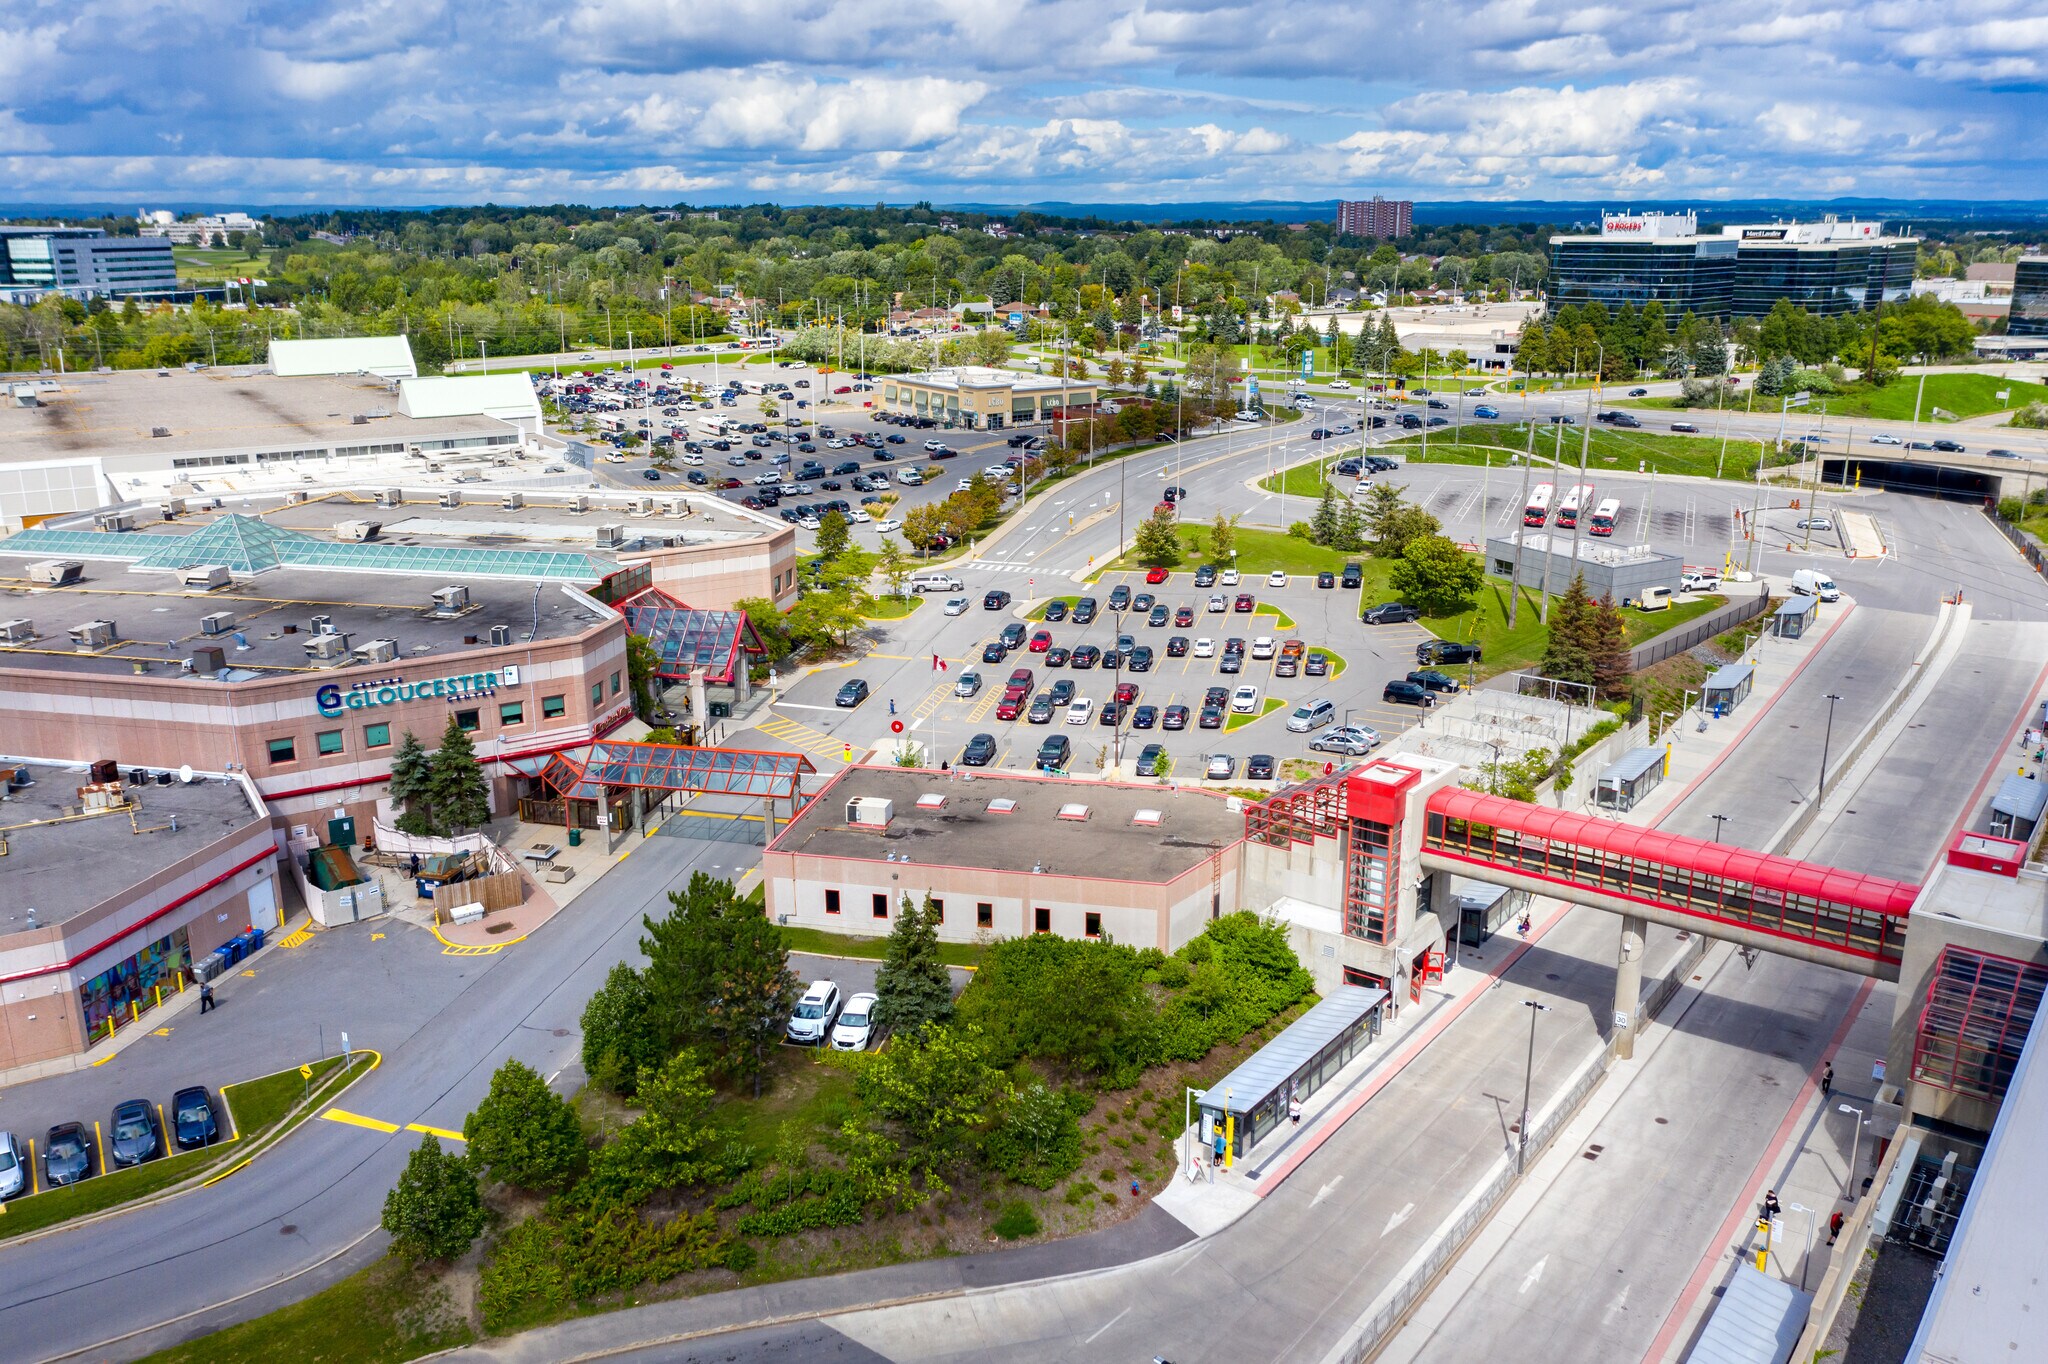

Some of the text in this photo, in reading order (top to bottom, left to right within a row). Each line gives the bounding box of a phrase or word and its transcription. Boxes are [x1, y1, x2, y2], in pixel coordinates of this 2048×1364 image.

[1615, 222, 1642, 230] ROGERS
[988, 398, 1004, 407] LCBO
[1046, 399, 1060, 407] LCBO
[352, 677, 402, 690] CENTRE
[345, 672, 500, 710] GLOUCESTER
[447, 690, 495, 703] CENTRE
[1617, 1016, 1626, 1024] 30
